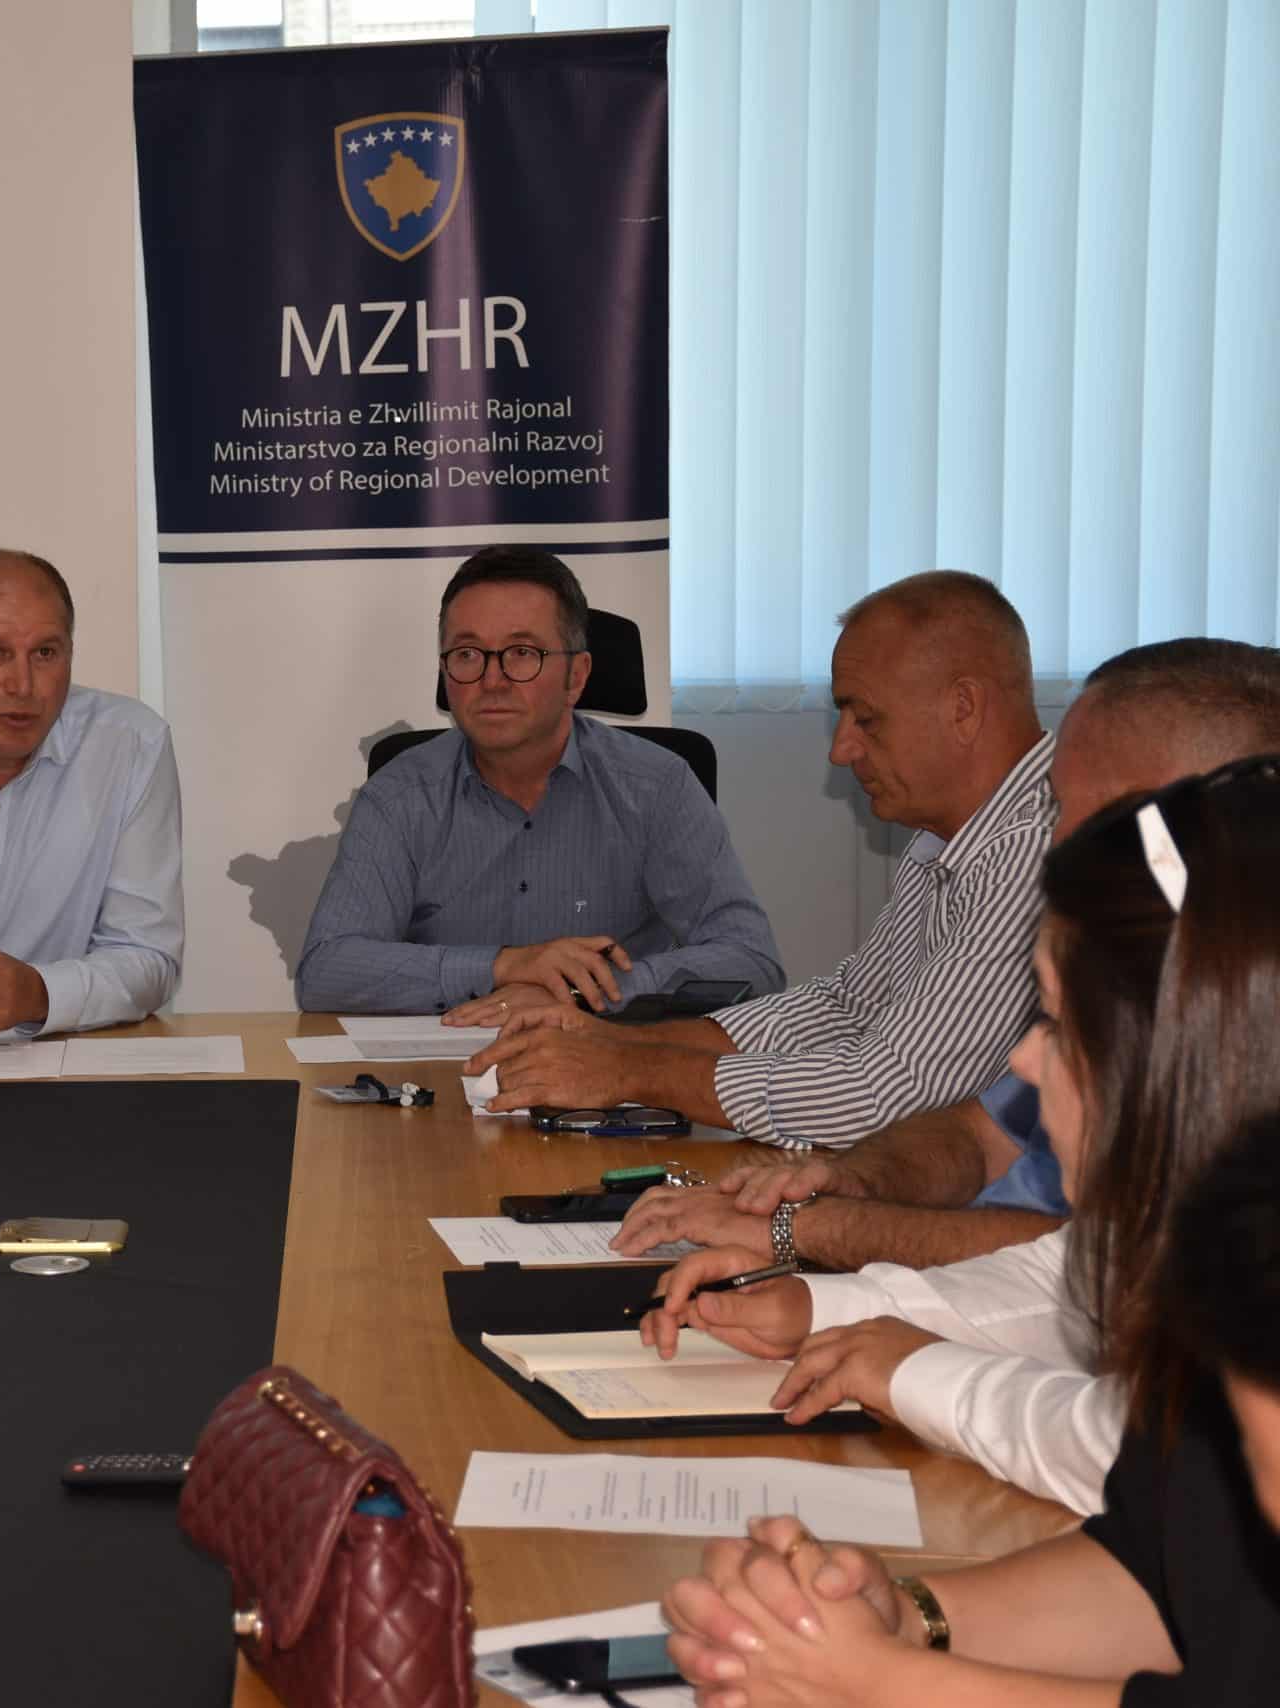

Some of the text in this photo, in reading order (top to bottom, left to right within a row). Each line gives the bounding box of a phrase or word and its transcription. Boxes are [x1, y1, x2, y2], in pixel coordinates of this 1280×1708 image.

[279, 295, 530, 378] MZHR
[241, 395, 572, 429] Ministria e Zhvillimit Rajonal
[213, 429, 604, 463] Ministarstvo za Regionalni Razvoj
[209, 463, 611, 498] Ministry of Regional Development
